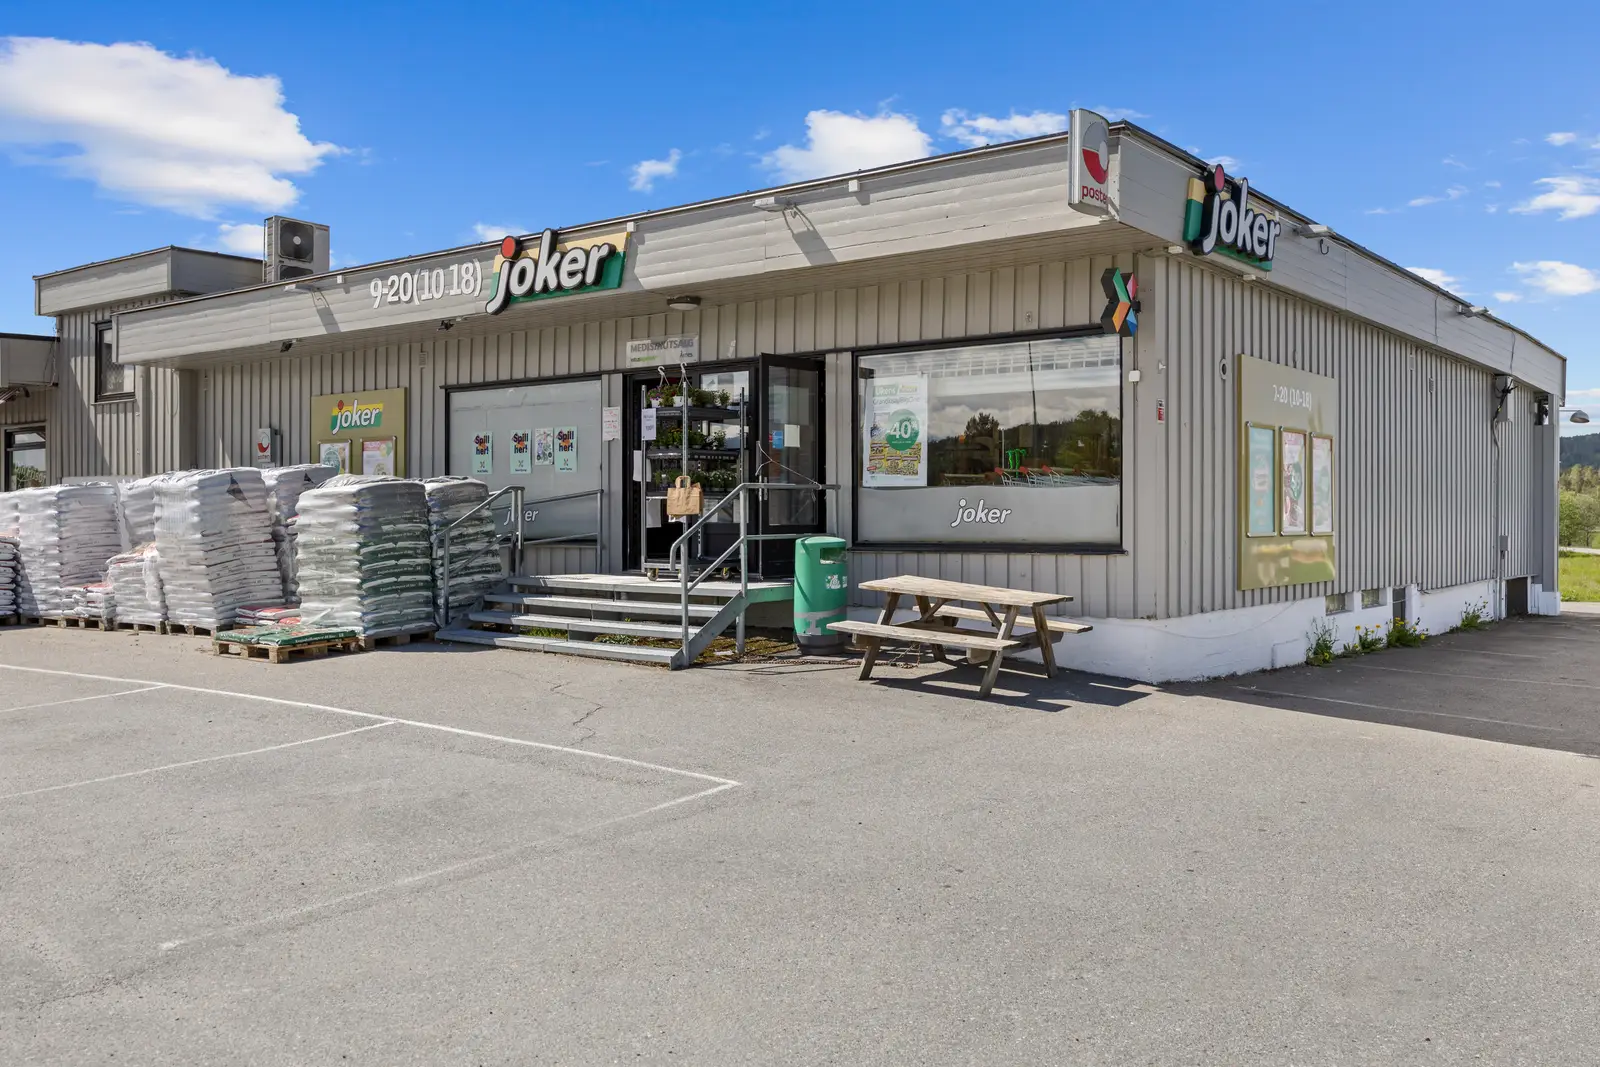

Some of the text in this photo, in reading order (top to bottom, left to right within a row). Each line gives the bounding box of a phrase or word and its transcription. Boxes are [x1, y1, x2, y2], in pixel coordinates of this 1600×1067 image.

[1081, 185, 1110, 205] poste
[1199, 164, 1281, 260] joker
[485, 228, 616, 315] joker
[332, 399, 380, 435] joker
[503, 507, 539, 526] jer
[950, 498, 1012, 528] joker
